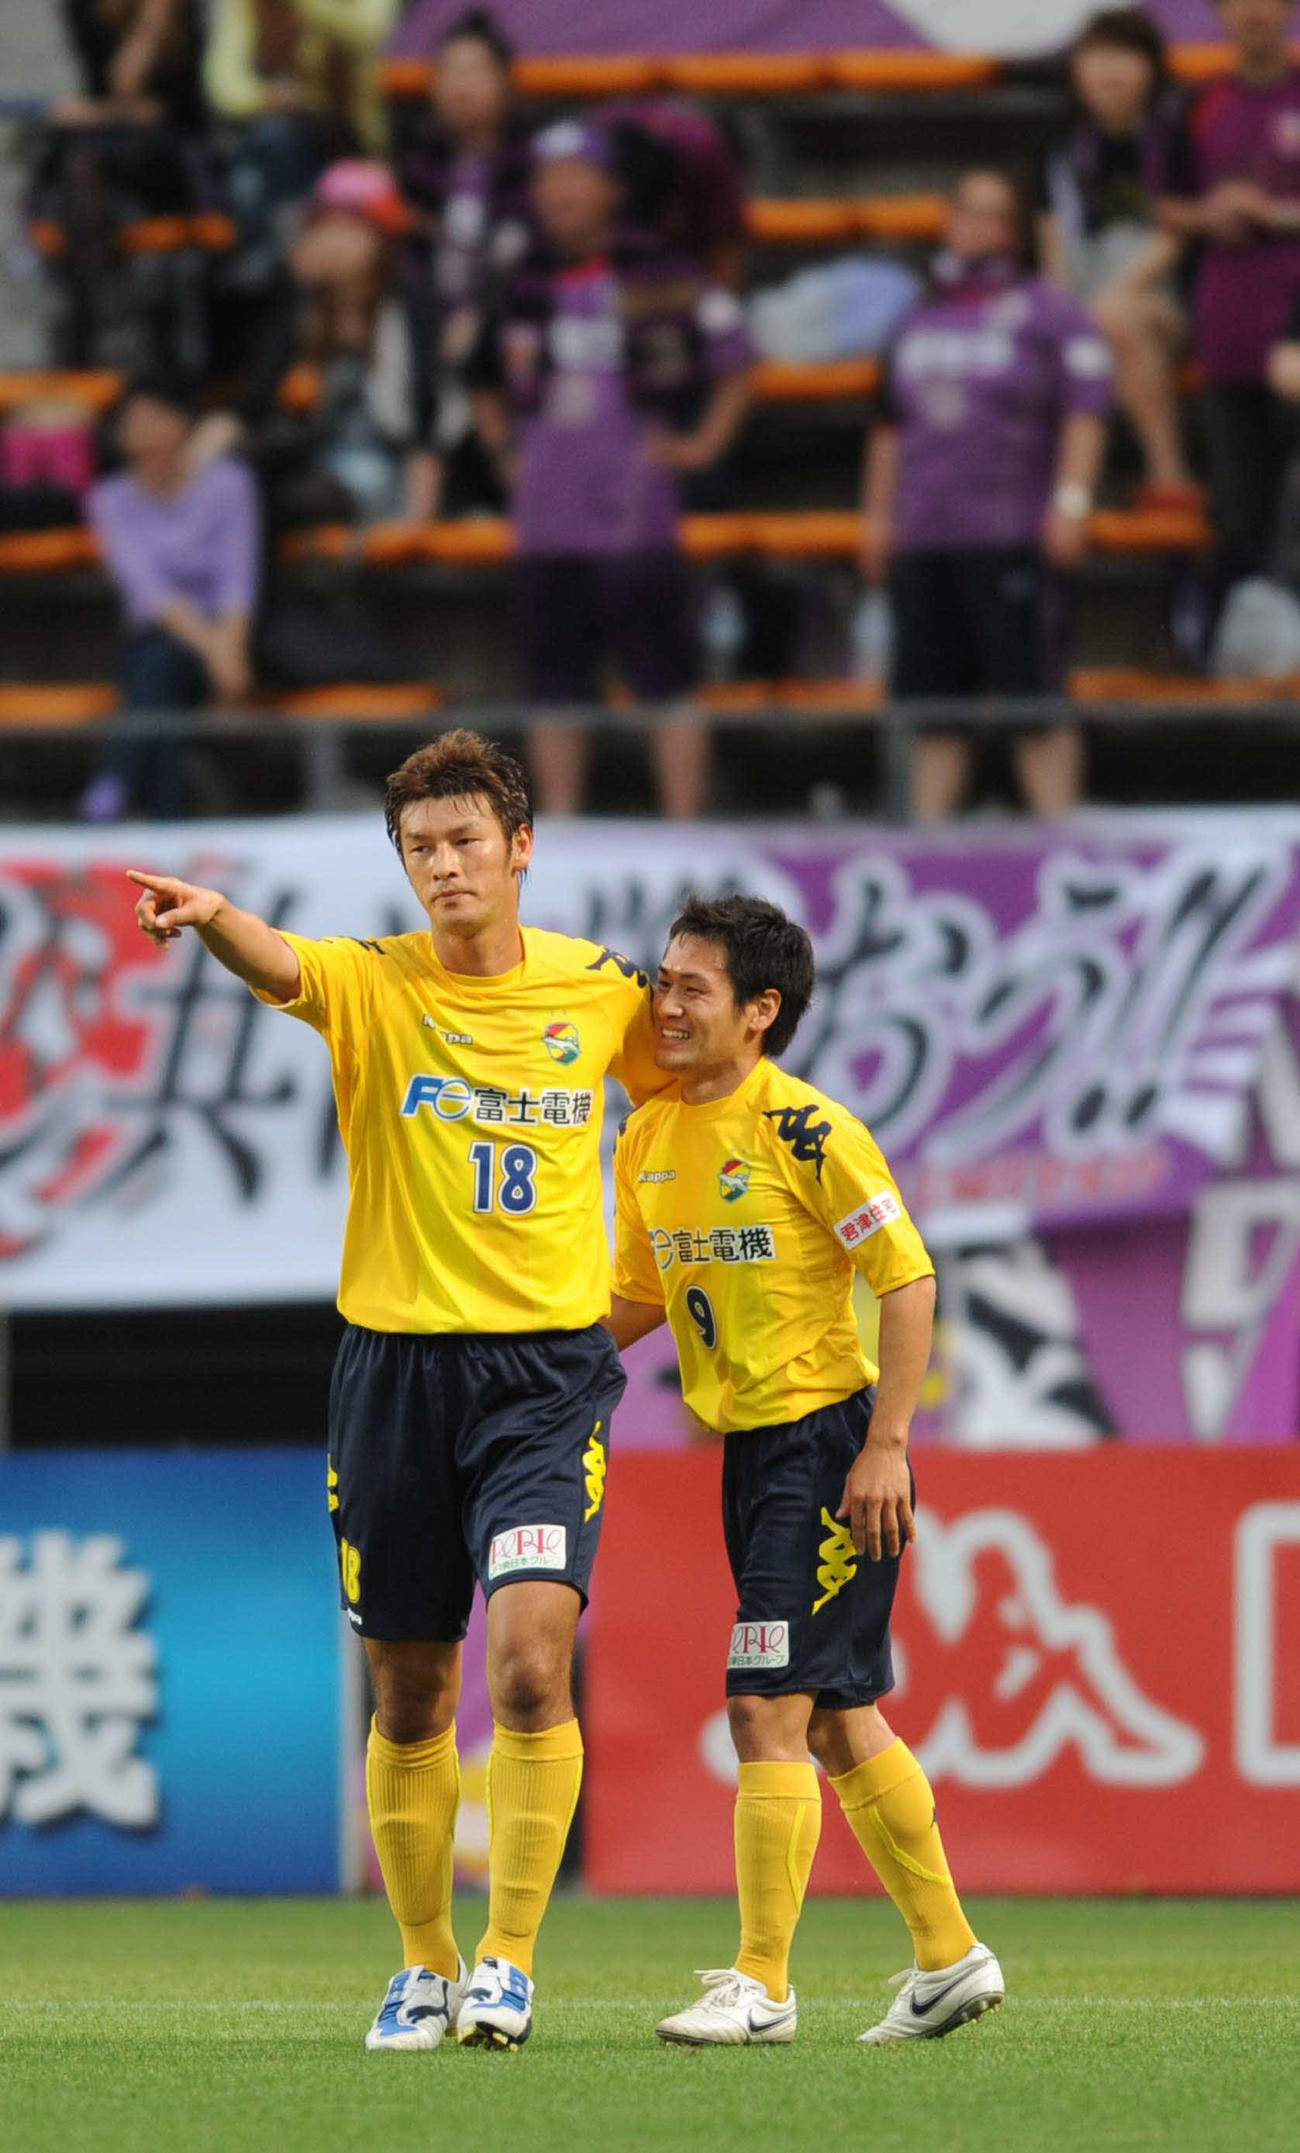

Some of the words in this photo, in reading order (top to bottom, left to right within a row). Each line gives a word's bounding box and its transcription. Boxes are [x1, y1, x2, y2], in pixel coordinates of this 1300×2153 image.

[474, 1088, 592, 1125] 富士電機
[469, 1141, 537, 1214] 18
[673, 1226, 774, 1262] 富士電機
[685, 1285, 717, 1350] 9
